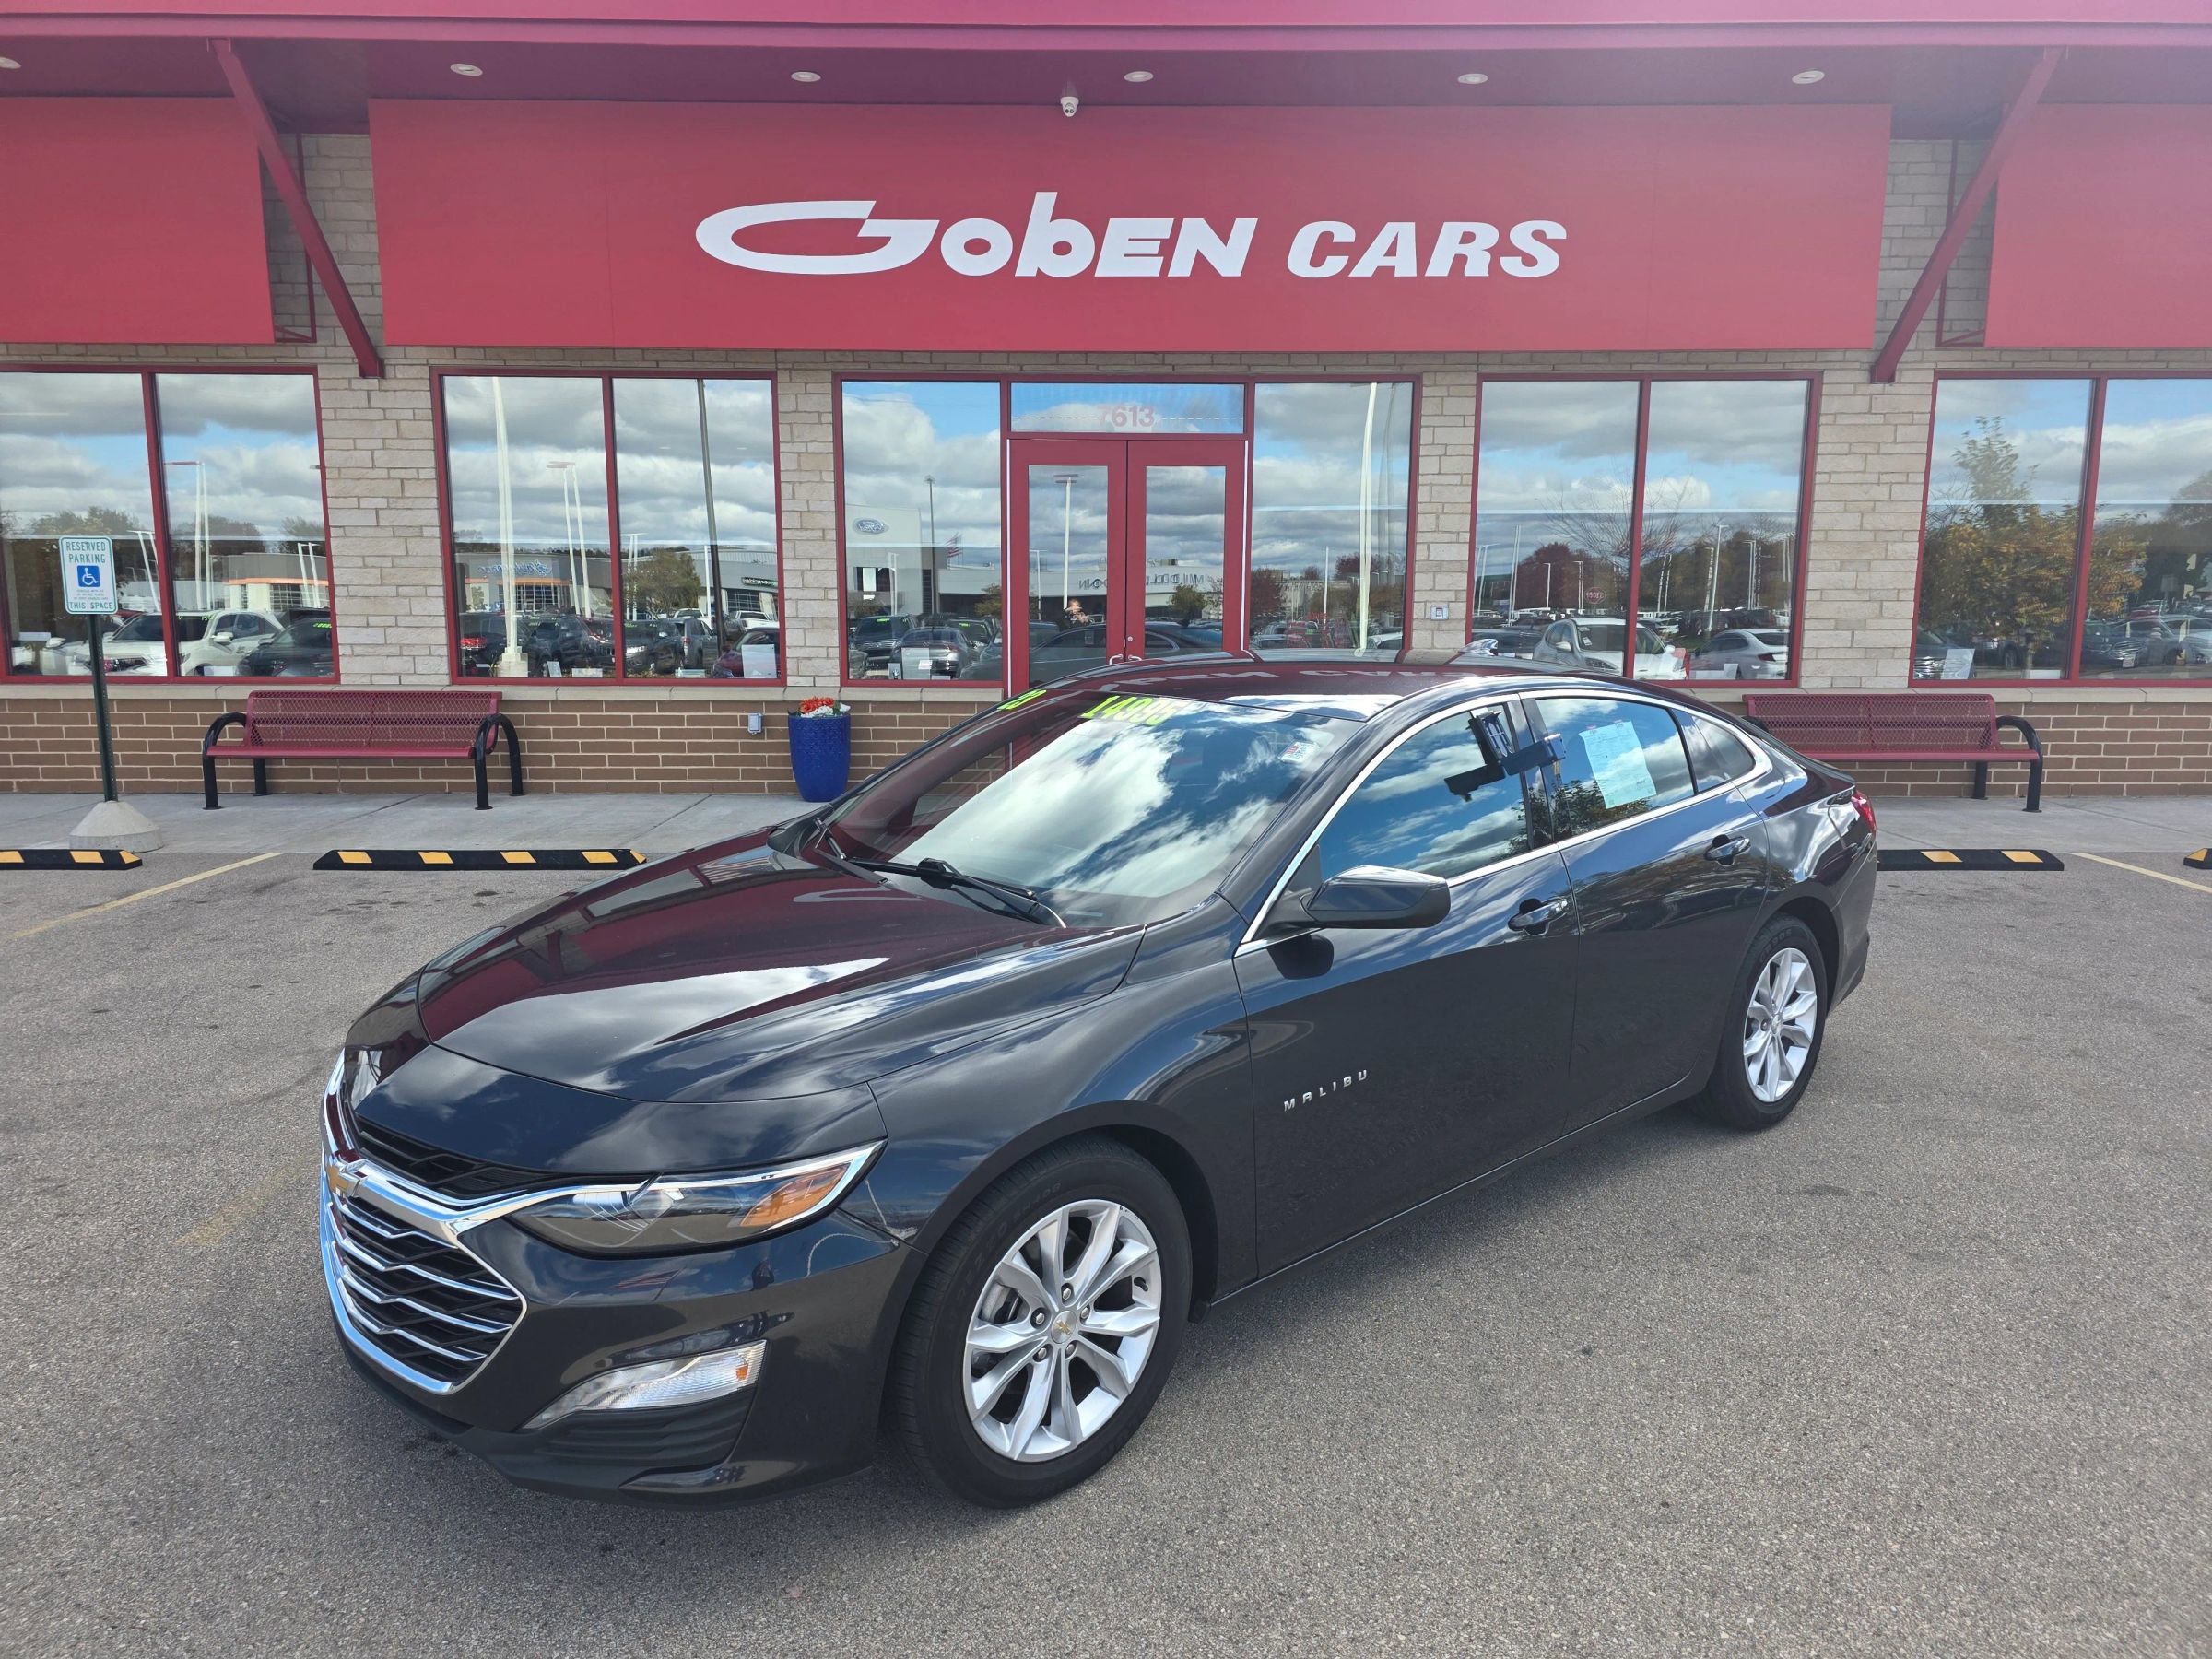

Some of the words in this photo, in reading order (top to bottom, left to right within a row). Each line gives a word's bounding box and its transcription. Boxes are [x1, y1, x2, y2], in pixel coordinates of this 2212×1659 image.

[1287, 219, 1567, 278] CARS
[1097, 404, 1155, 428] 7613
[65, 541, 106, 552] RESERVED
[68, 553, 105, 563] PARKING
[1080, 695, 1189, 726] 14995
[1283, 1069, 1368, 1112] MALIBU
